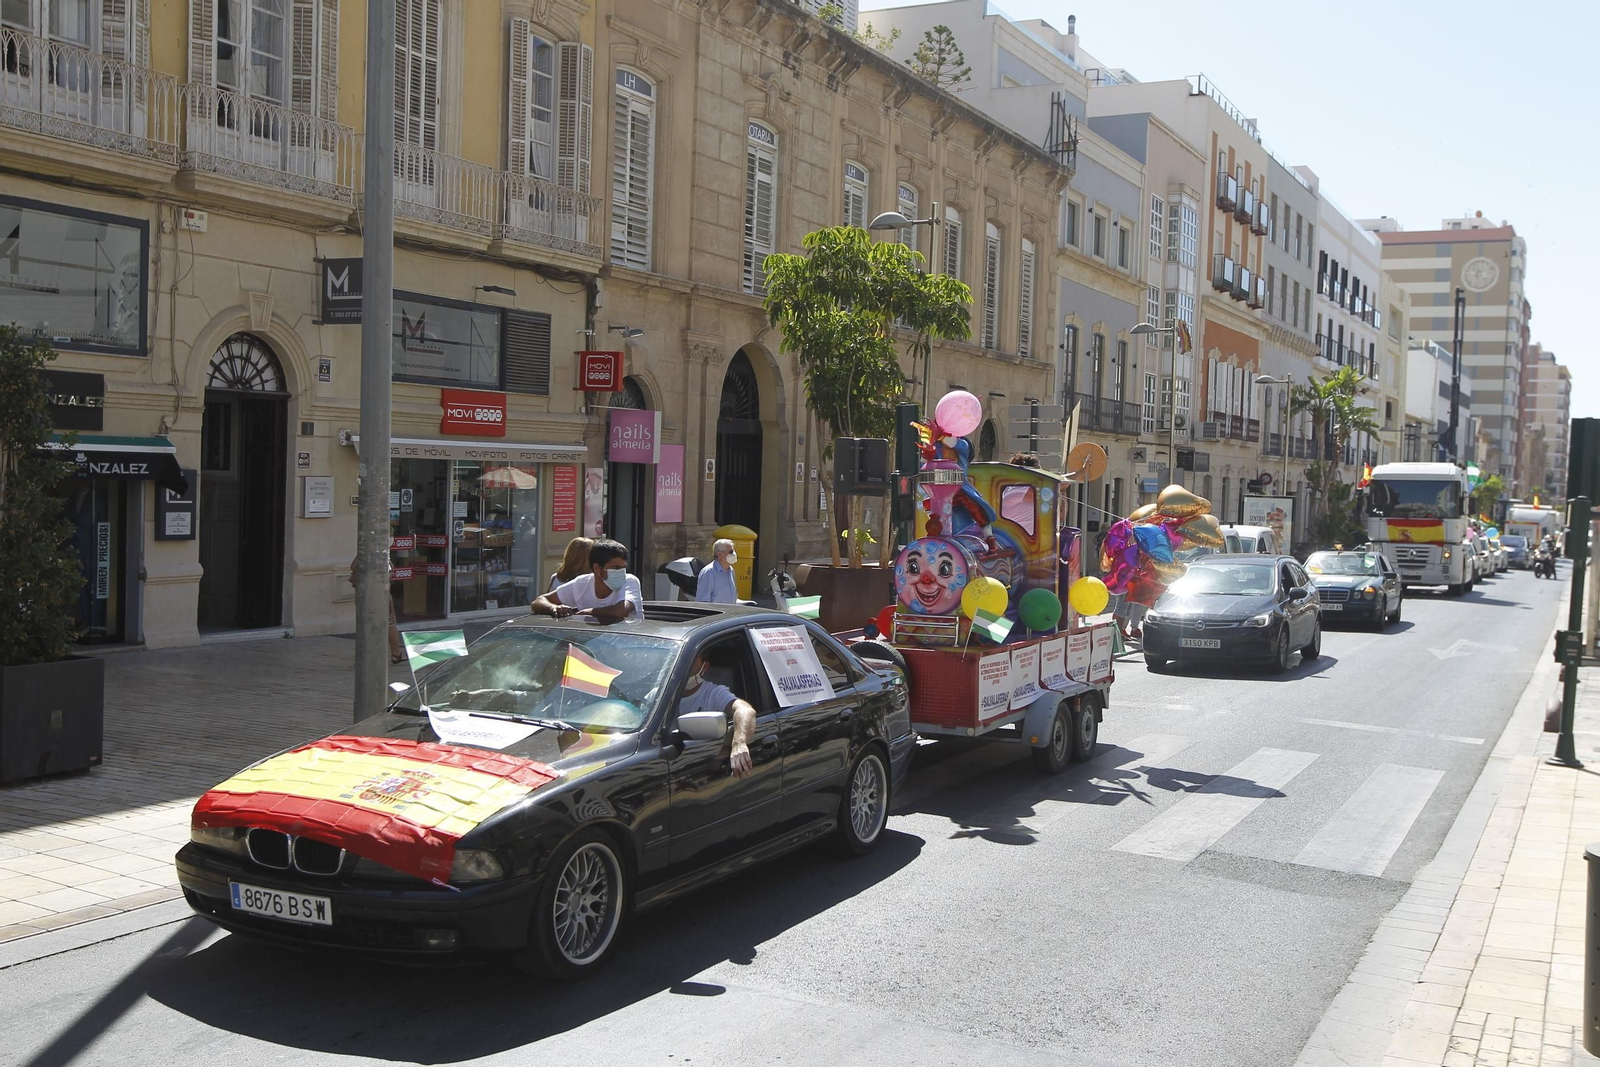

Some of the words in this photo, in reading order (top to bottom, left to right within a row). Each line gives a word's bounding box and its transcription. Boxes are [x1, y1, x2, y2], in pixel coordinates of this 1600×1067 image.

[624, 72, 636, 90] LH
[447, 408, 473, 419] MOVI
[613, 423, 652, 440] nails
[405, 447, 419, 456] DE
[424, 445, 452, 457] MÓVIL
[465, 450, 508, 459] MOVIFOTO
[520, 452, 548, 460] FOTOS
[658, 472, 683, 487] nails
[1183, 639, 1202, 647] 3150
[1203, 640, 1219, 648] KPB
[244, 888, 283, 914] 8676
[288, 896, 326, 921] BSW
